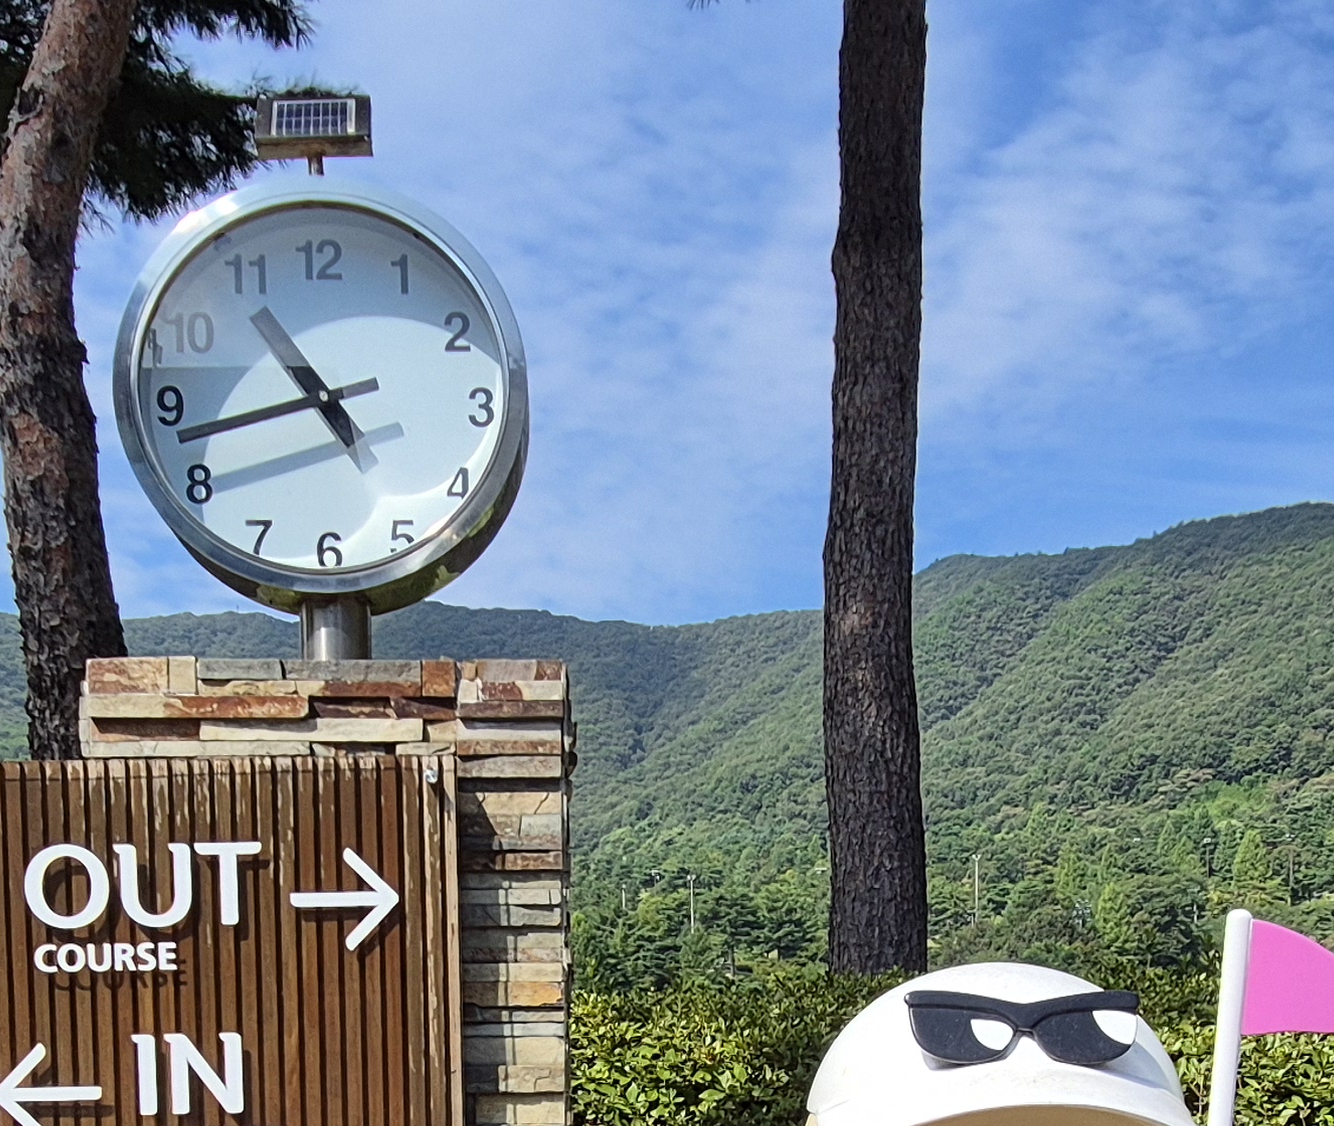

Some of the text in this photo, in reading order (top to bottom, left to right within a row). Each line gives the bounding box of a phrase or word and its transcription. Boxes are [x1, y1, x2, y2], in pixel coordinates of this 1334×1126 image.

[224, 254, 267, 295] 11
[295, 239, 343, 281] 12
[391, 254, 409, 295] 1
[163, 311, 215, 354] 10
[444, 312, 471, 352] 2
[156, 385, 184, 426] 9
[468, 387, 495, 428] 3
[185, 463, 213, 504] 8
[447, 467, 470, 500] 4
[245, 520, 273, 556] 7
[316, 532, 344, 568] 6
[389, 519, 415, 553] 5
[23, 841, 263, 929] OUT
[34, 941, 178, 974] COURSE
[130, 1031, 245, 1116] IN
